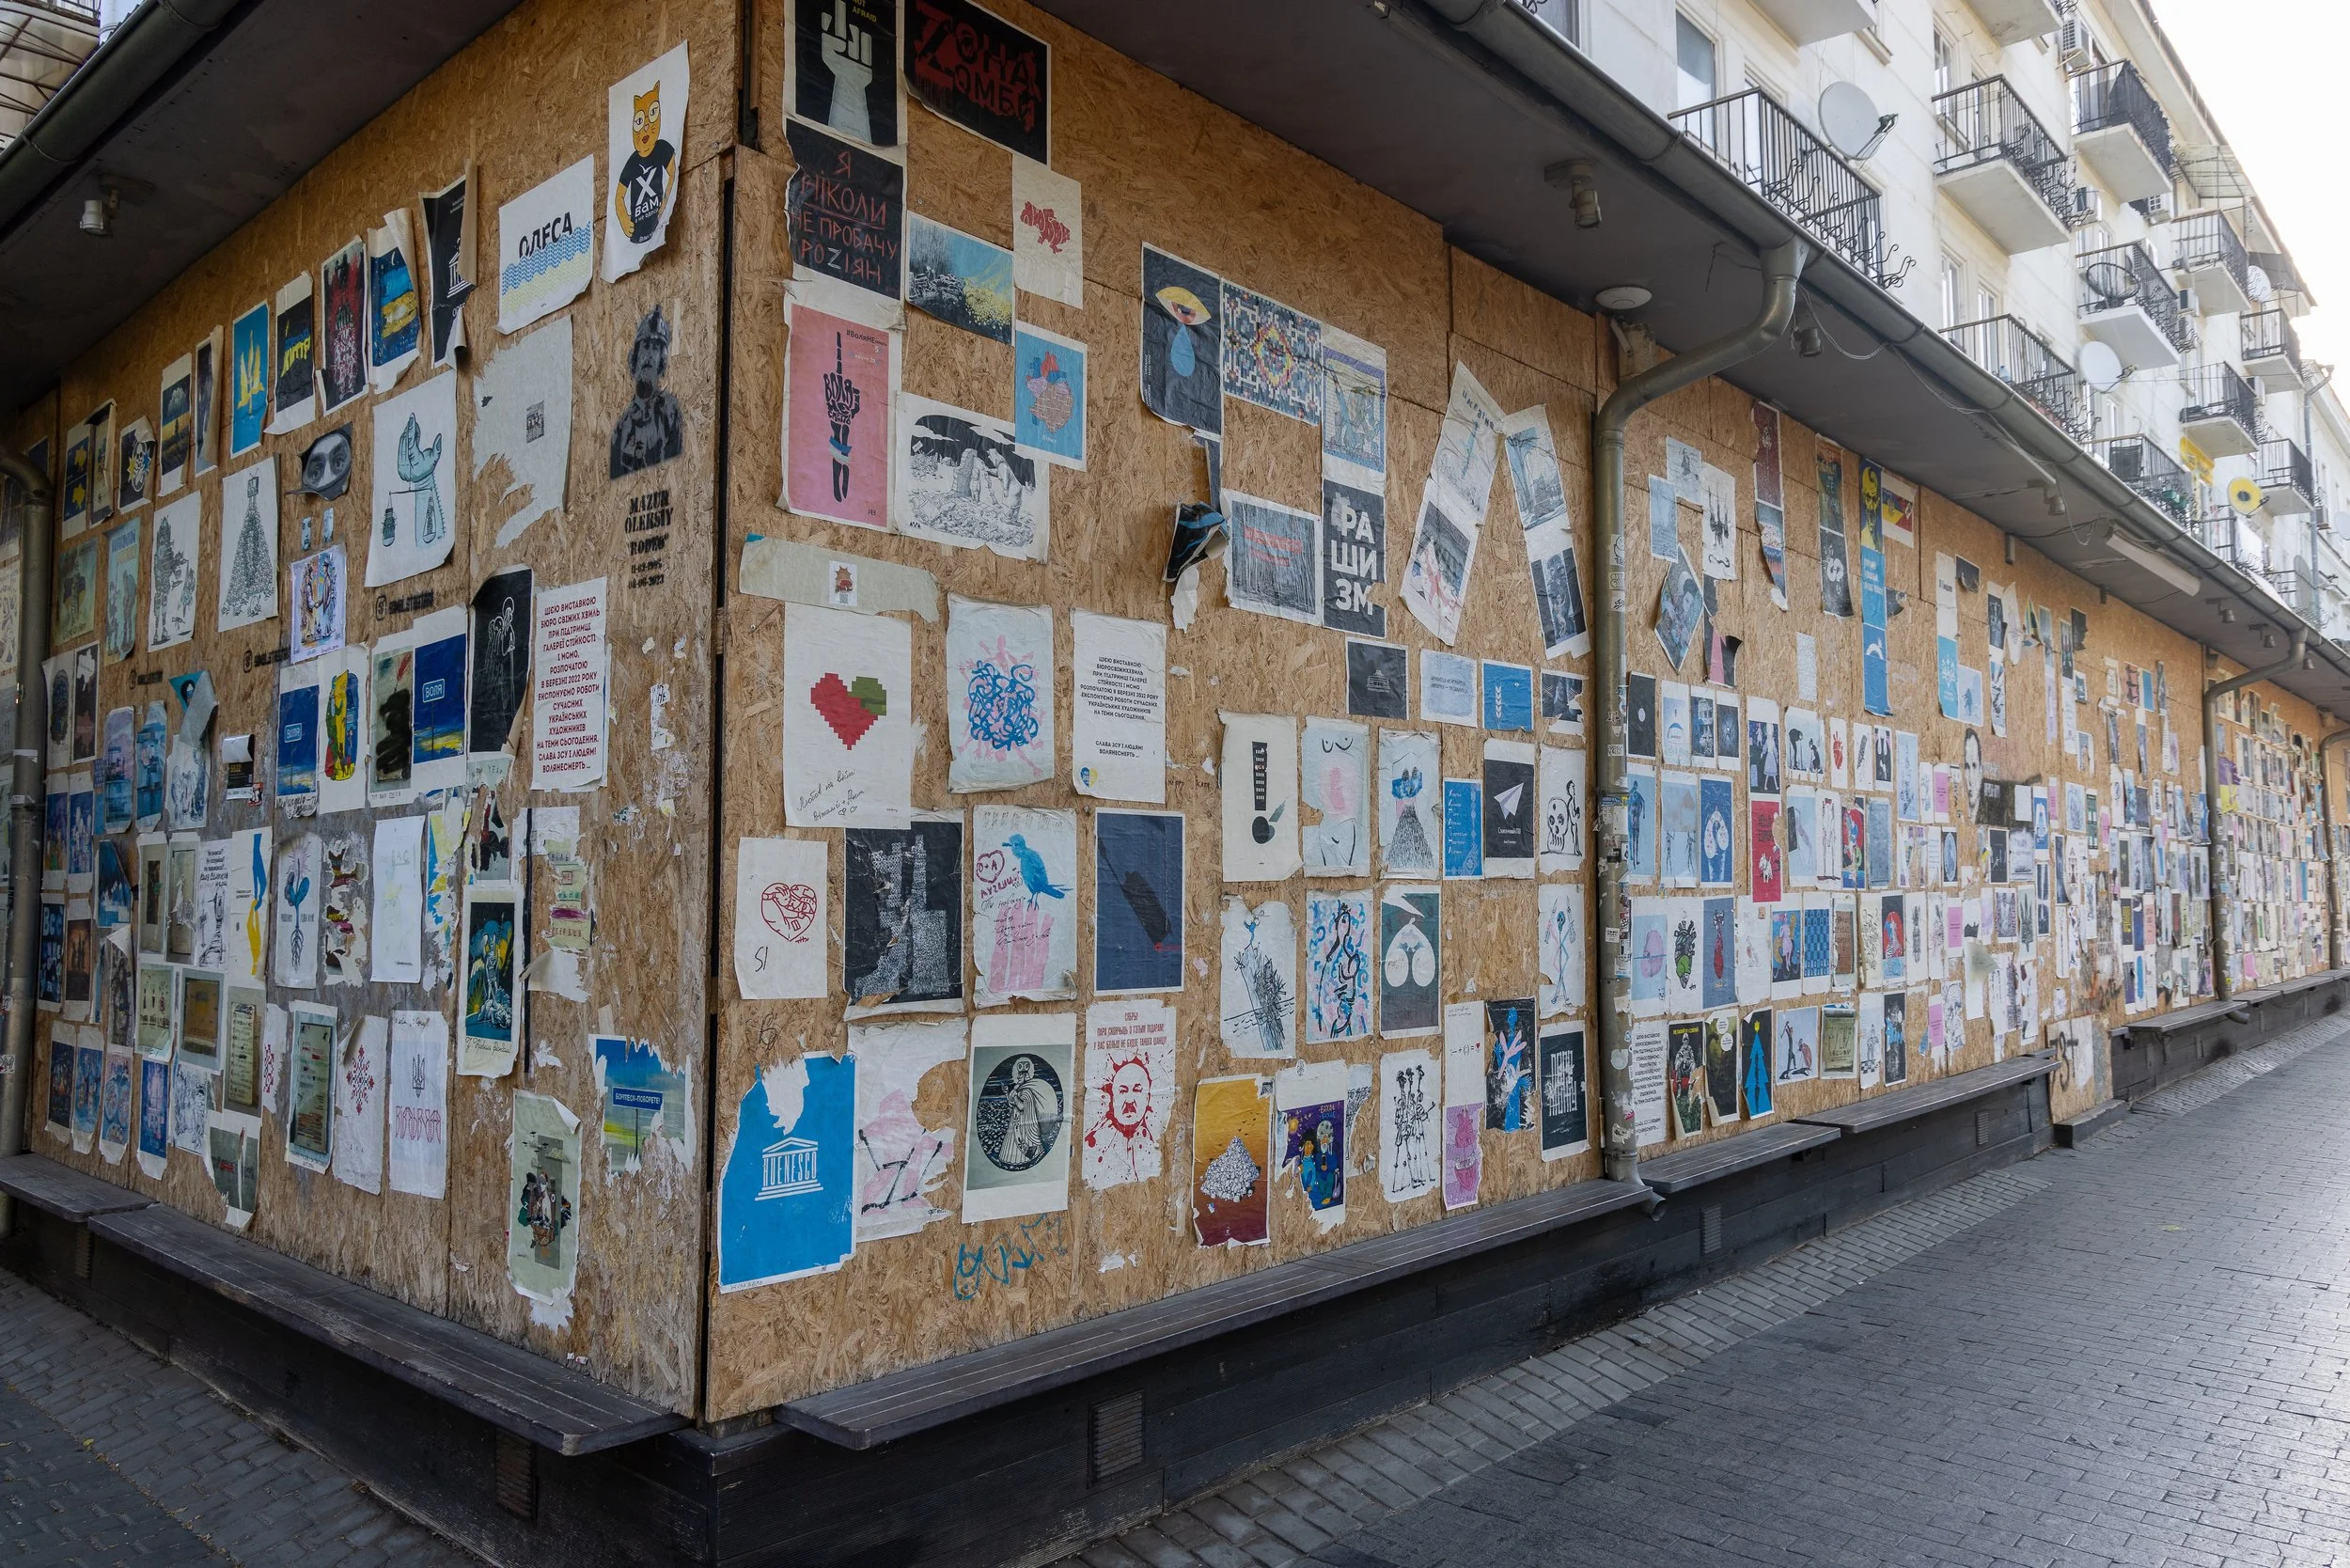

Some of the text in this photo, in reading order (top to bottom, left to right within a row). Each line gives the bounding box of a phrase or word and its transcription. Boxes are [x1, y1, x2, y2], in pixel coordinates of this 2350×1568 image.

[853, 6, 877, 22] AFRAID
[832, 151, 851, 179] Я
[520, 212, 572, 259] ОДЕСА
[820, 217, 897, 259] ПРОБАЧУ
[1331, 540, 1377, 580] ШИ
[561, 596, 596, 611] ВИСТАВКОЮ
[1336, 579, 1373, 615] ЗМ
[541, 609, 600, 628] БЮРО СВІЖИХ ХВИЛЬ
[548, 623, 591, 639] ПРИ ПІДТРИМЦІ
[543, 634, 595, 652] ГАЛЕРЕЇ СТІЙКОСТІ
[550, 661, 588, 674] РОЗПОЧАТОЮ
[1113, 659, 1142, 667] ВИСТАВКОЮ
[546, 676, 567, 688] БЕРЕЗНІ
[568, 674, 580, 684] 2022
[581, 672, 597, 682] РОКУ
[1097, 679, 1123, 688] СТІЙКОСТІ
[425, 684, 443, 698] ВОЛЯ
[538, 684, 600, 701] ЕКСПОНУЄМО РОБОТИ
[1080, 684, 1112, 694] РОЗПОЧАТОЮ
[553, 699, 583, 710] СУЧАСНИХ
[1088, 701, 1120, 710] УКРАЇНСЬКИХ
[548, 711, 587, 723] УКРАЇНСЬКИХ
[548, 723, 586, 736] ХУДОЖНИКІВ
[545, 738, 559, 748] ТЕМИ
[538, 753, 556, 761] СЛАВА
[557, 750, 568, 759] ЗСУ
[572, 747, 596, 757] ЛЮДЯМ!
[543, 761, 585, 773] ВОЛЯНЕСМЕРТЬ
[1121, 1039, 1126, 1048] НЕ
